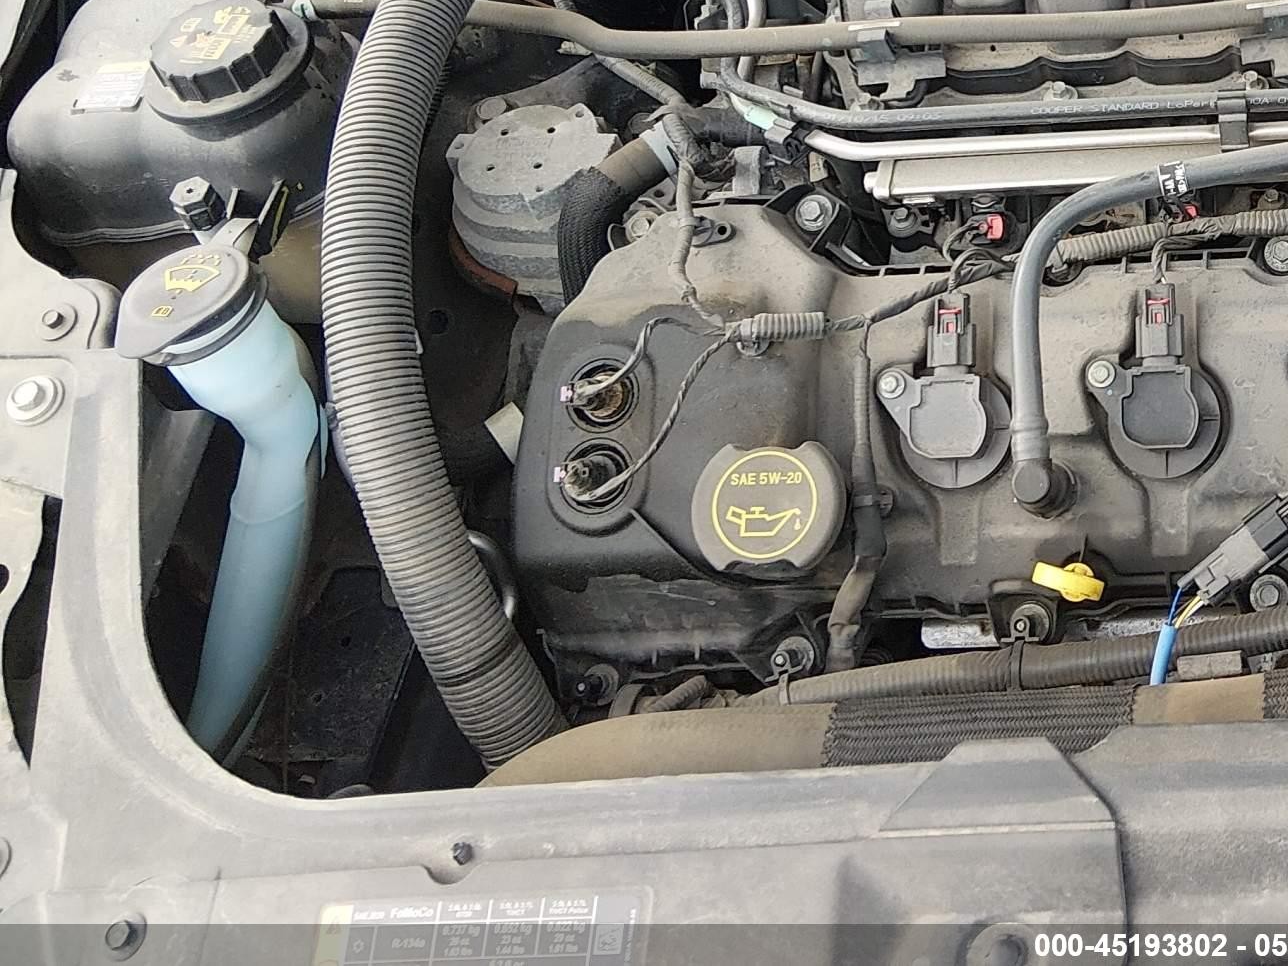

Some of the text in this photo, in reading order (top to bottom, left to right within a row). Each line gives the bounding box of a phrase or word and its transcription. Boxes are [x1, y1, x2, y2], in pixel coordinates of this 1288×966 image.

[1030, 105, 1081, 115] COOPER
[1091, 101, 1160, 113] STANDARD
[730, 471, 803, 486] SAE 5W-20
[390, 906, 434, 919] FoMoCo
